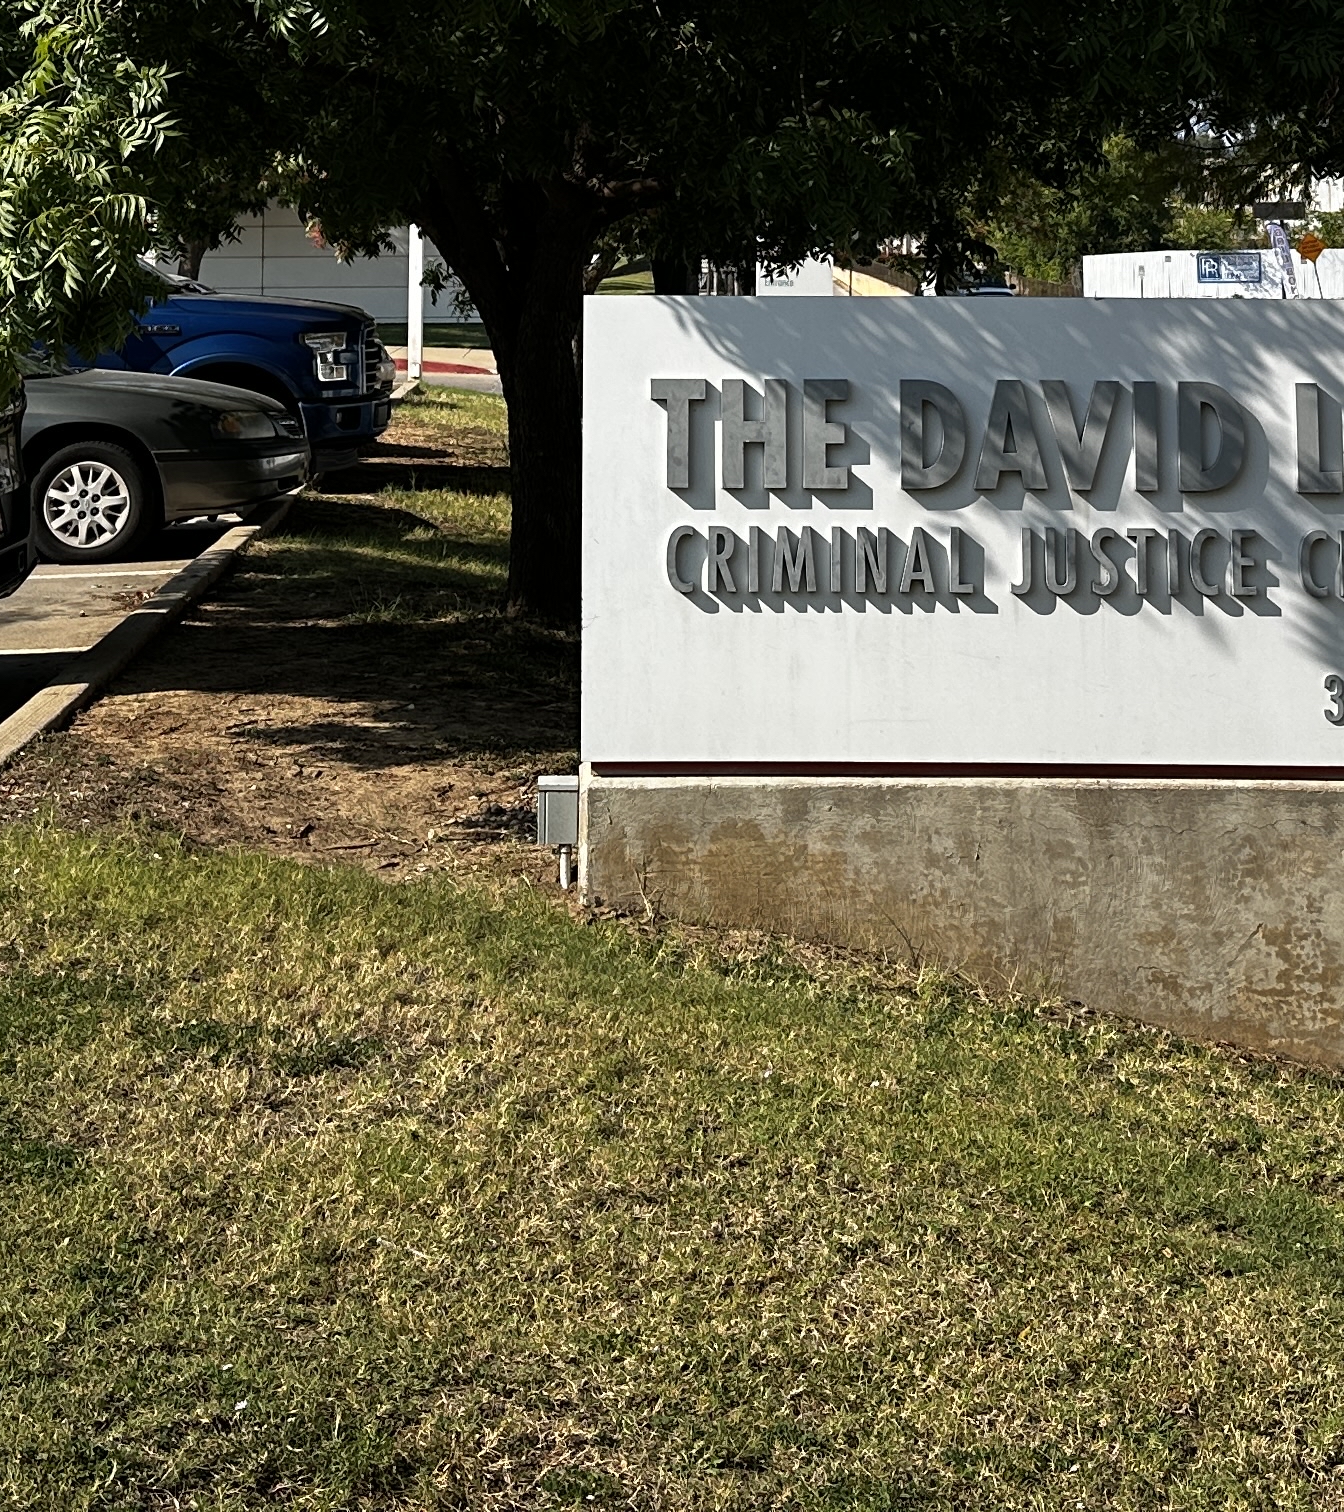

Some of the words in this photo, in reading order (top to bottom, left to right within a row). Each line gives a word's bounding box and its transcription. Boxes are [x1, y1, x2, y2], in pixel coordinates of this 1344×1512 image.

[650, 378, 849, 489] THE
[899, 378, 1248, 492] DAVID
[666, 525, 973, 595] CRIMINAL
[1010, 526, 1259, 597] JUSTICE
